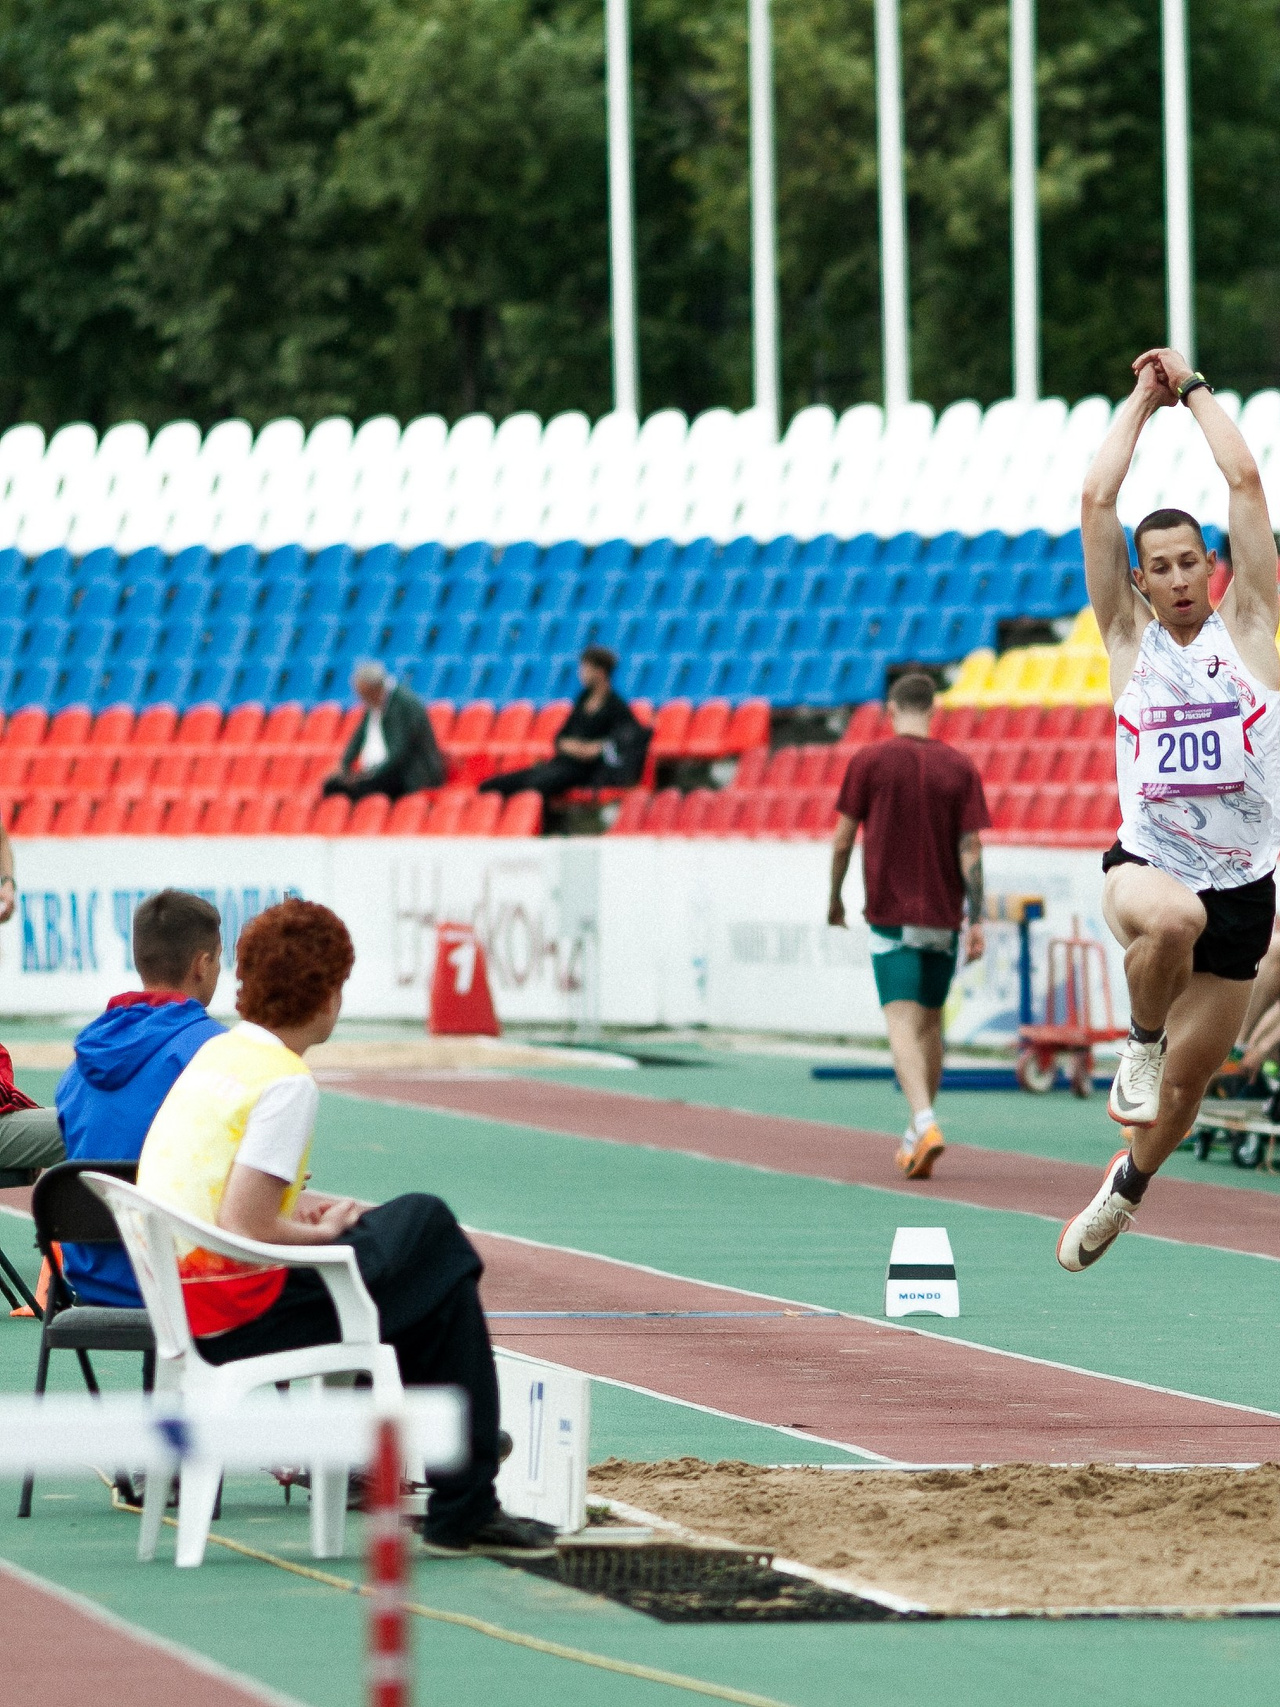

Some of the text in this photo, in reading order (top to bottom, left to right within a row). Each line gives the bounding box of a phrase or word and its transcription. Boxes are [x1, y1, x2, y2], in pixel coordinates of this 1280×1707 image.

[1158, 730, 1221, 773] 209
[20, 889, 98, 972] КВАС
[448, 942, 477, 995] 1
[898, 1292, 941, 1300] MONDO
